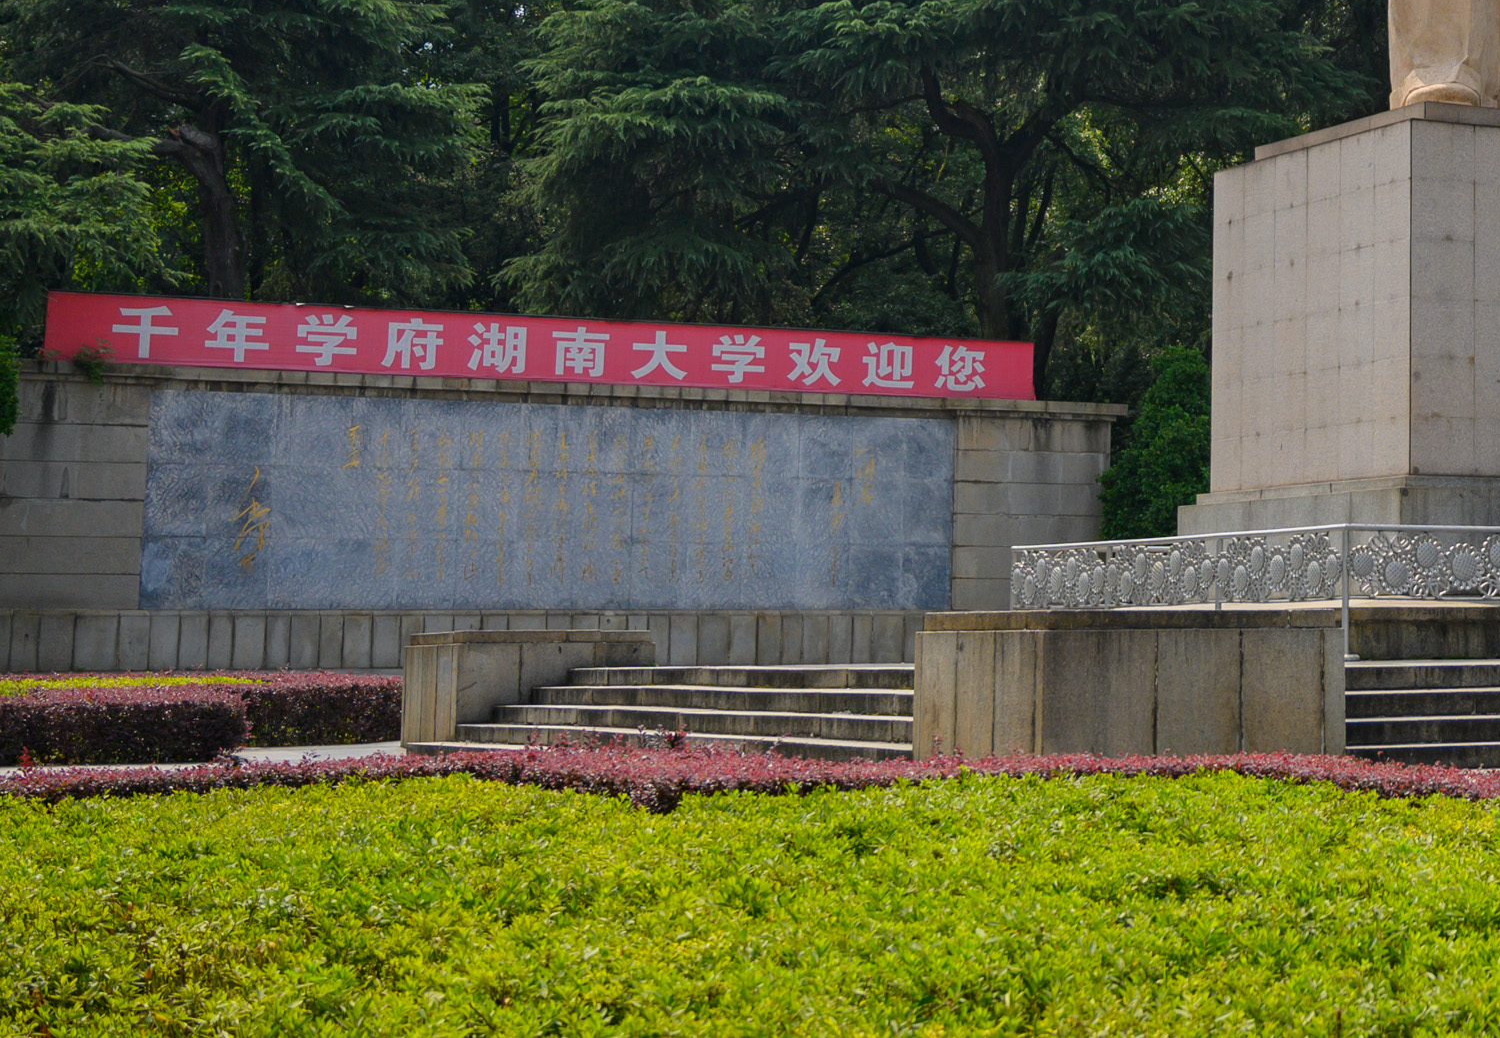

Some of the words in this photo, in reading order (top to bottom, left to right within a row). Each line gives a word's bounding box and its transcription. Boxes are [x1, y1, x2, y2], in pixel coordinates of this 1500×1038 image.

[112, 306, 985, 391] 千年学府湖南大学欢迎您
